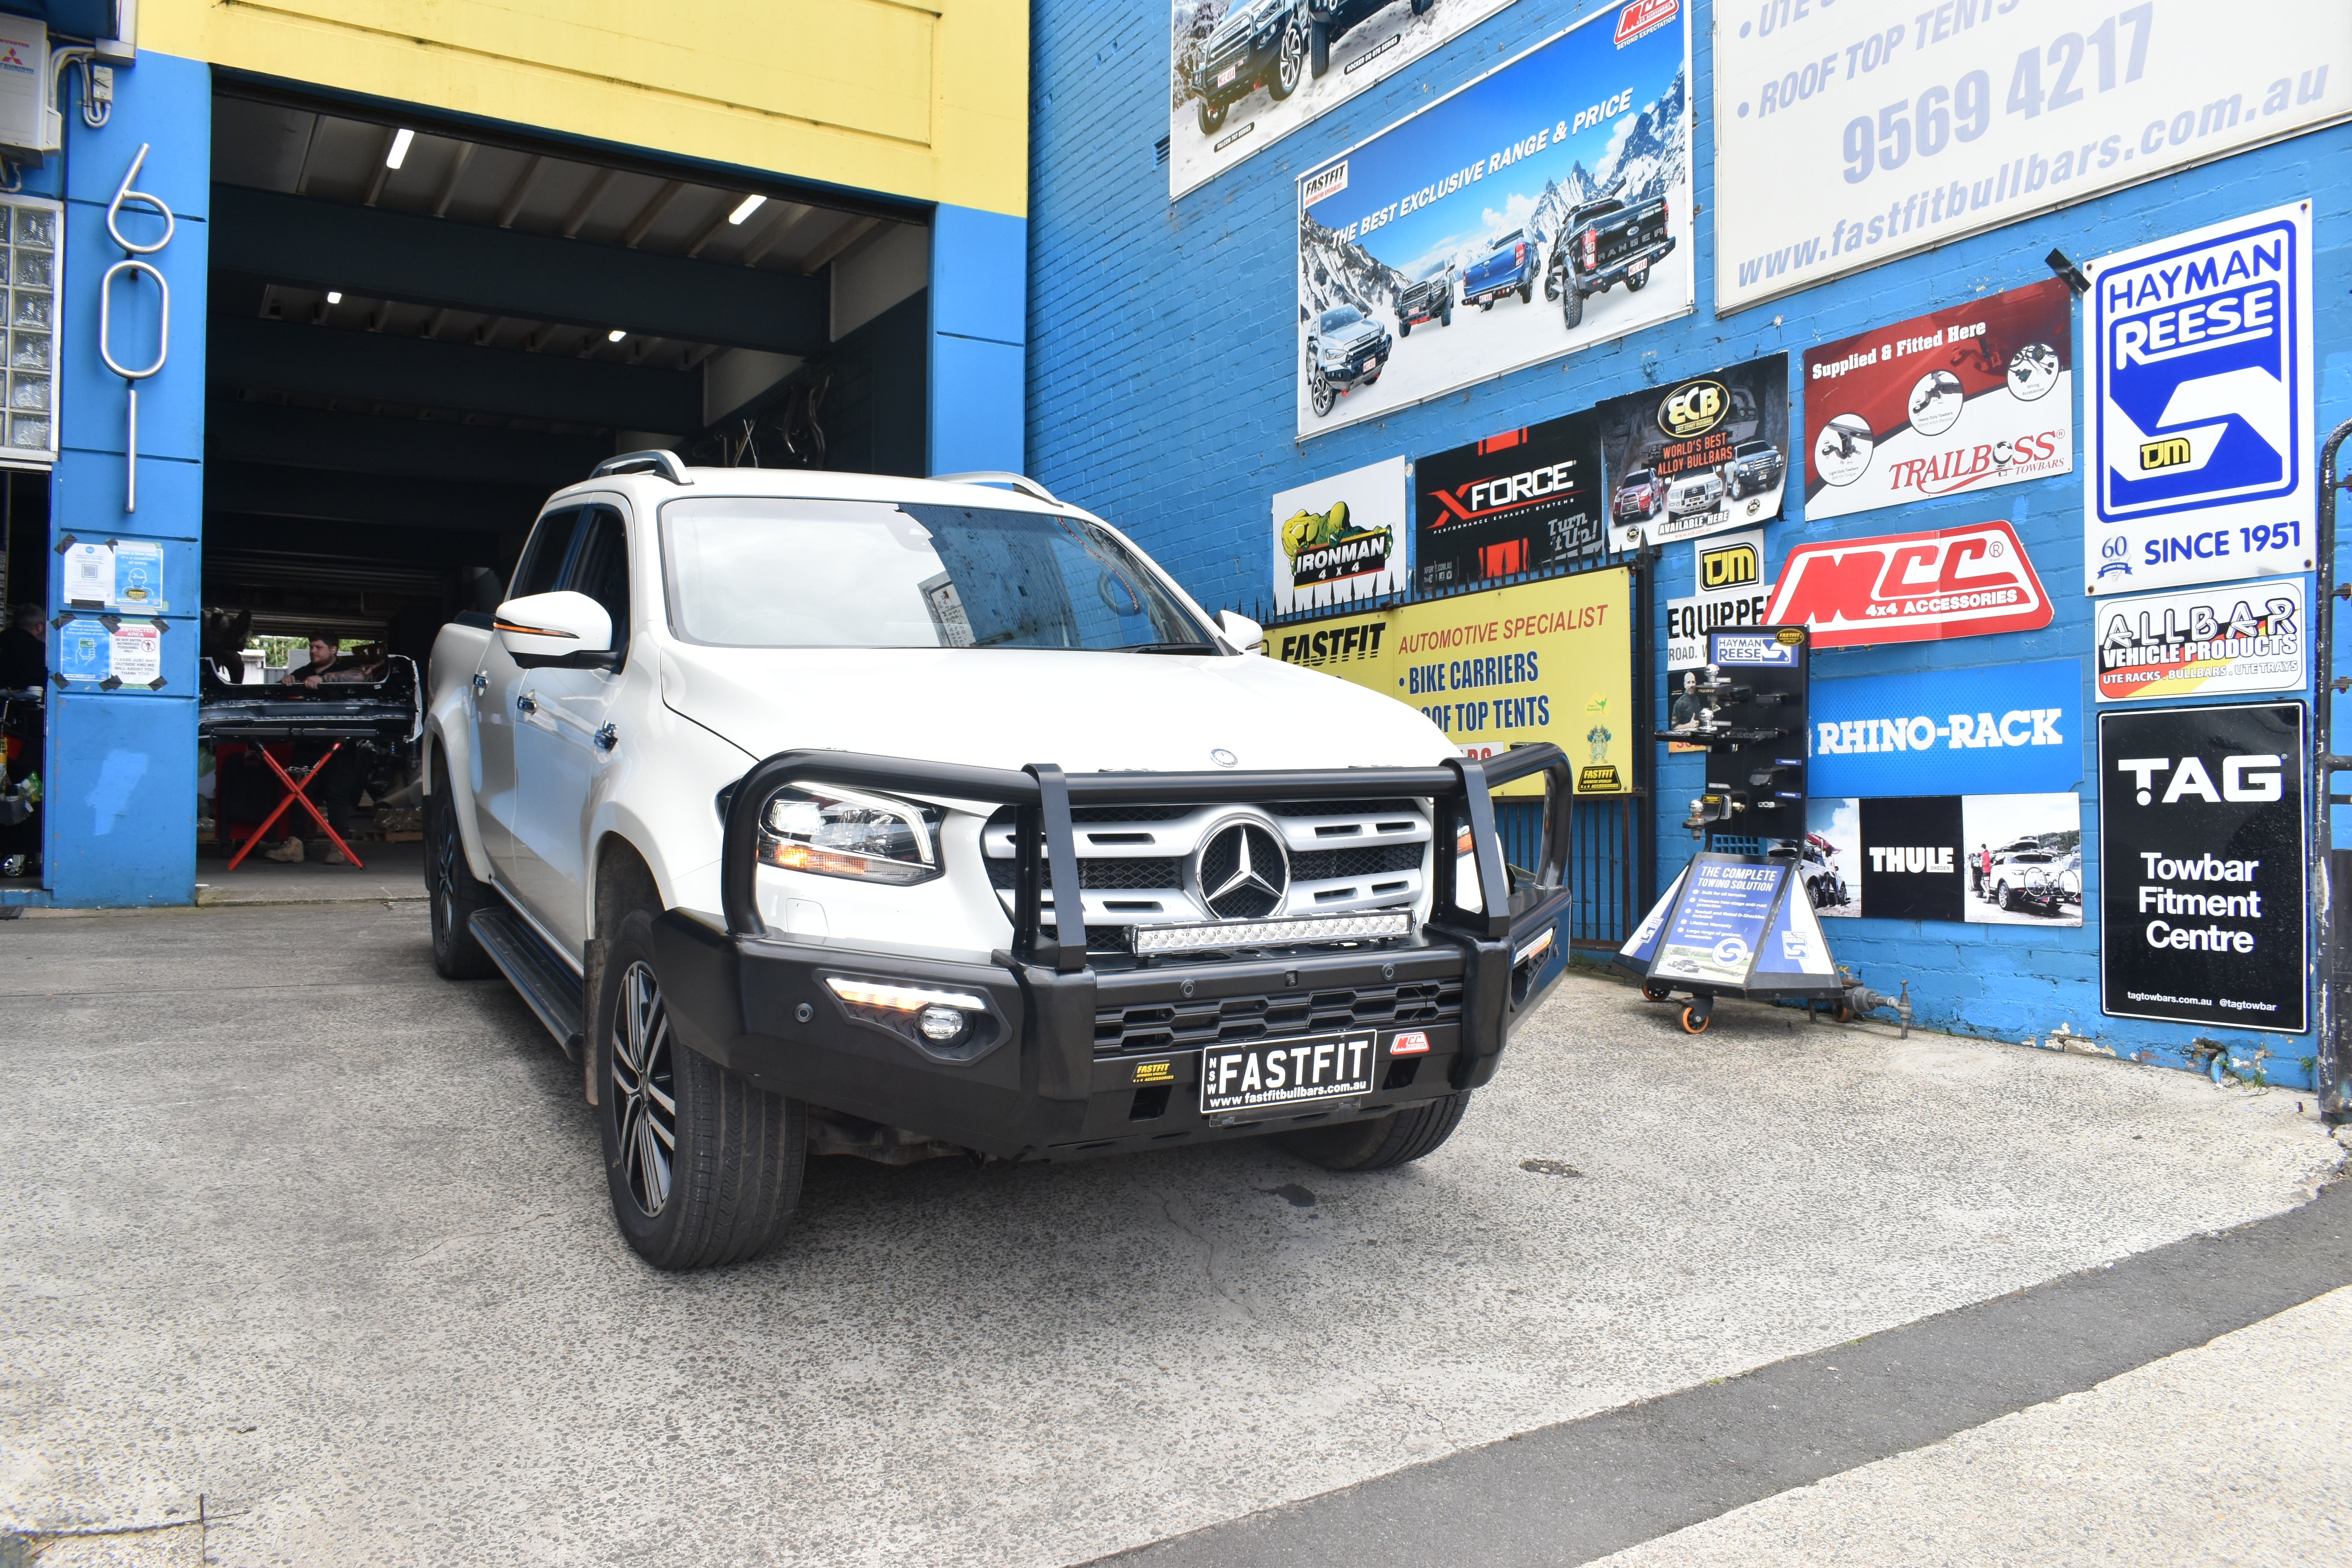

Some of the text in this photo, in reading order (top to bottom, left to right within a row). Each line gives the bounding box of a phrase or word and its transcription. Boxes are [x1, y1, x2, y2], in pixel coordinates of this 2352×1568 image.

[1646, 3, 1671, 20] ACCESSORIES
[1617, 14, 1677, 51] BEYOND EXPECTATION
[1347, 58, 1364, 73] ROCKER
[1381, 36, 1398, 51] SERIES
[1759, 23, 1906, 119] ROOF TOP
[1842, 0, 2154, 185] 9569 4217
[1217, 137, 1231, 150] FALCON
[1238, 125, 1251, 136] SERIES
[1305, 164, 1346, 198] FASTFIT
[1331, 87, 1634, 249] THE BEST EXCLUSIVE RANGE & PRICE
[1737, 64, 2330, 288] www.fastfitbullbars.com.au
[1597, 227, 1664, 262] RANGER
[1629, 260, 1648, 275] MCC 4X4
[2110, 239, 2281, 313] HAYMAN
[2116, 287, 2273, 370] REESE
[1812, 321, 1987, 381] Supplied & Fitted Here
[1668, 386, 1720, 425] ECB
[1658, 445, 1733, 475] ALLOY BULLBARS
[1663, 432, 1727, 459] WORLD'S BEST
[1888, 430, 2056, 493] TRAILBOSS
[2015, 458, 2065, 475] TOWBARS
[1426, 460, 1573, 529] XFORCE
[1433, 497, 1575, 535] PERFORMANCE EXHAUST SYSTEMS
[1548, 512, 1588, 536] Turn
[1658, 517, 1703, 535] AVAILABLE
[1707, 511, 1729, 525] HERE
[1675, 527, 1711, 539] www.ecb.com.au
[1296, 536, 1385, 574] IRONMAN
[2102, 520, 2300, 566] 60 SINCE 1951
[1318, 562, 1360, 580] 4 4
[1704, 548, 1755, 586] TJM
[1777, 538, 2018, 624] MCC
[1865, 589, 2018, 617] 4x4 ACCESSORIES
[1281, 604, 1608, 667] FASTFIT AUTOMOTIVE SPECIALIST
[2104, 597, 2297, 650] ALLBAR
[1668, 646, 1697, 662] ROAD.
[1719, 639, 1761, 647] HAYMAN
[1719, 648, 1761, 661] REESE
[2103, 633, 2298, 669] VEHICLE PRODUCTS
[1409, 650, 1539, 695] BIKE CARRIERS
[2103, 660, 2299, 685] UTE RACKS BULLBARS UTE TRAYS
[1455, 695, 1550, 732] TOP TENTS
[1817, 708, 2063, 755] RHINO-RACK
[1583, 769, 1614, 779] FASTFIT
[2118, 754, 2282, 806] TAG
[1701, 866, 1777, 881] THE COMPLETE
[1869, 847, 1954, 873] THULE
[2140, 852, 2259, 882] Towbar
[1697, 878, 1773, 892] TOWING SOLUTION
[2139, 885, 2262, 918] Fitment
[2146, 920, 2254, 953] Centre
[2127, 991, 2277, 1012] tagtowbars.com.au @tagtowbar
[1396, 1036, 1425, 1050] MCC
[1137, 1063, 1170, 1074] FASTFIT
[1218, 1040, 1368, 1094] FASTFIT
[1210, 1080, 1367, 1108] www fastfitbullbars.com.au
